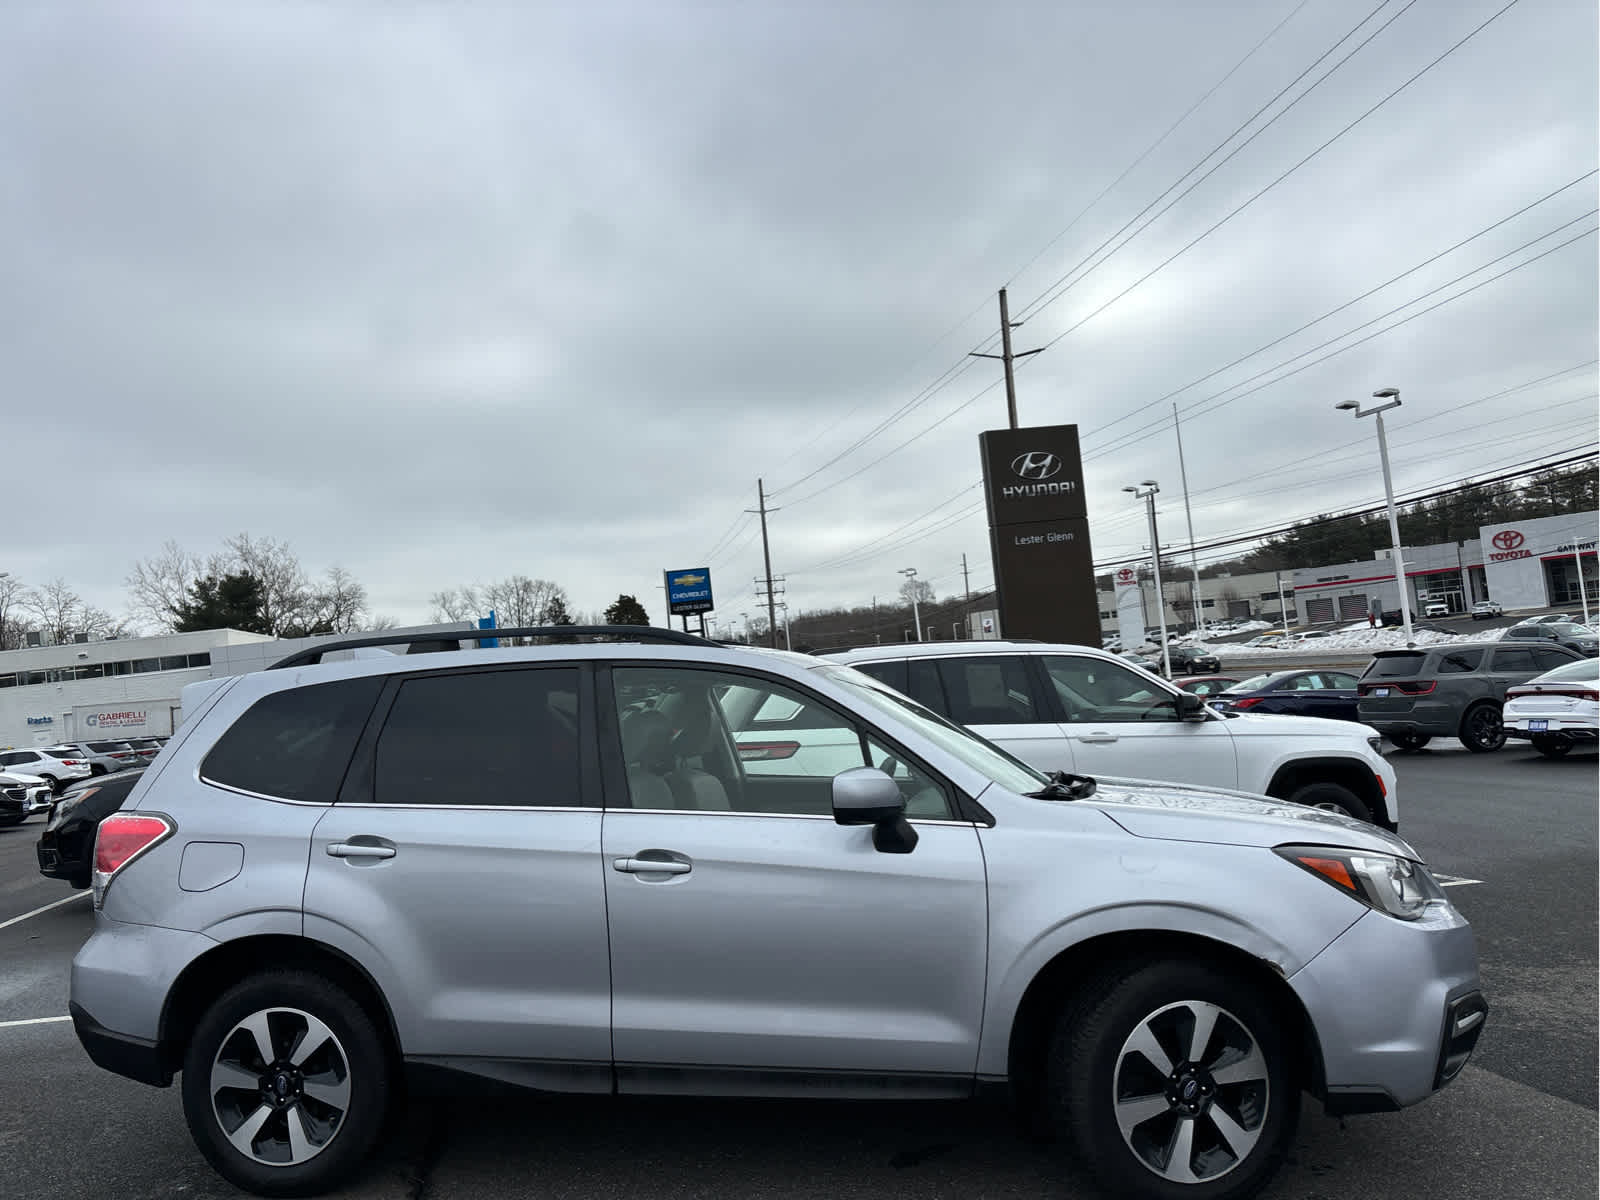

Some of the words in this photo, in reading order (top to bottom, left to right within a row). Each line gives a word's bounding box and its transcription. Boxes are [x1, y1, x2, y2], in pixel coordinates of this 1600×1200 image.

[1003, 481, 1075, 497] HYUNDAI
[1015, 535, 1044, 545] Lester
[1047, 532, 1074, 542] Glenn
[1489, 549, 1532, 560] TOYOTA
[672, 591, 708, 599] CHEVROLET
[27, 716, 53, 725] Parts
[98, 711, 147, 721] GABRIELLI
